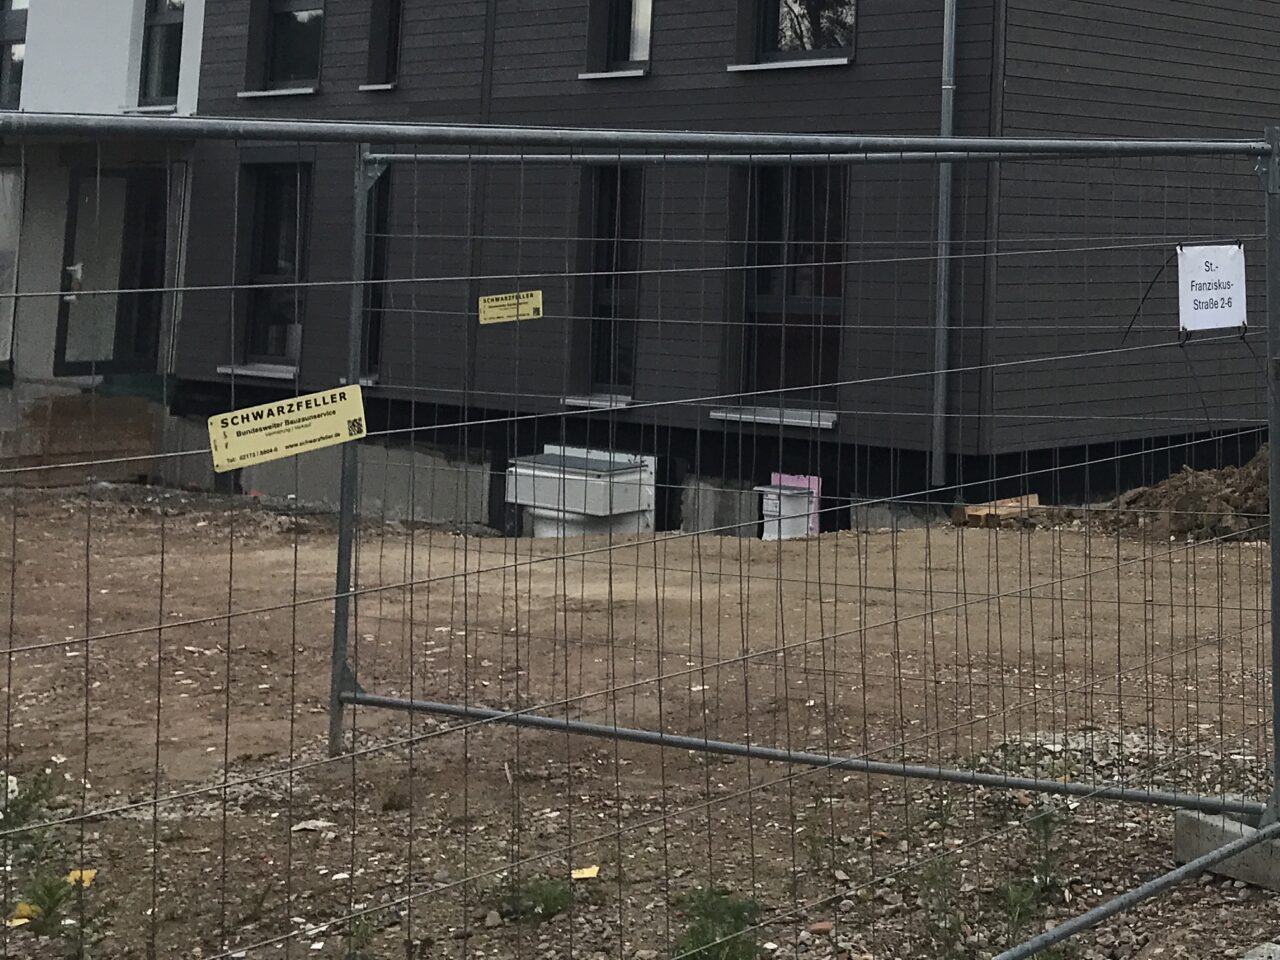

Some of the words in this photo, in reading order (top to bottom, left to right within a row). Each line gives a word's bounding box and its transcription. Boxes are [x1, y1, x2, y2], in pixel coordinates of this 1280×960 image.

[1204, 260, 1219, 273] St.-
[1190, 279, 1234, 292] Franziskus-
[1193, 298, 1219, 311] Straße
[1220, 296, 1233, 309] 2-6
[220, 391, 348, 429] SCHWARZFELLER
[235, 422, 283, 438] Bundesweiter
[284, 409, 337, 427] Bauzaunservice
